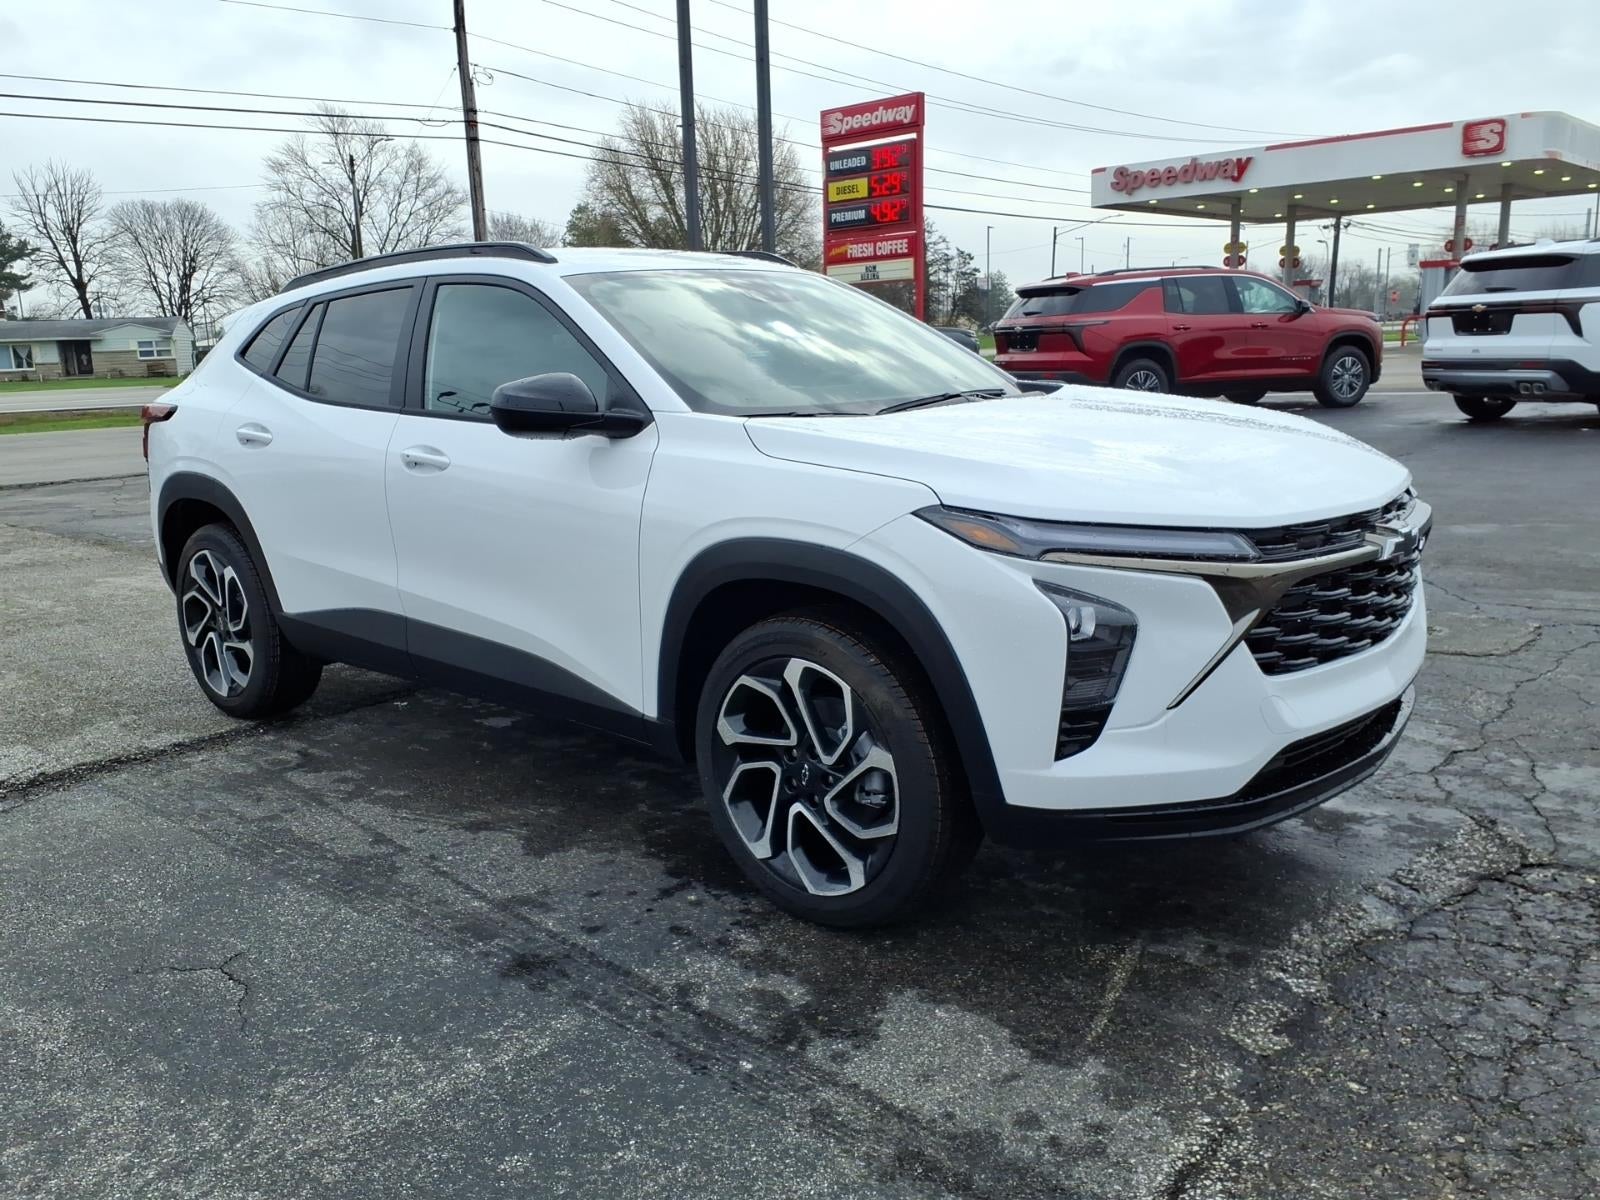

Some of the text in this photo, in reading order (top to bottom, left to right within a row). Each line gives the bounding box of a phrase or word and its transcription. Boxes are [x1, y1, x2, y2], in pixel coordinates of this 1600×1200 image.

[825, 104, 916, 135] Speedway
[1471, 121, 1504, 150] S
[829, 156, 866, 171] UNLEADED
[1110, 156, 1254, 196] Speedway
[835, 184, 860, 196] DIESEL
[831, 209, 866, 223] PREMIUM
[847, 243, 874, 259] FRESH
[876, 238, 909, 256] COFFEE
